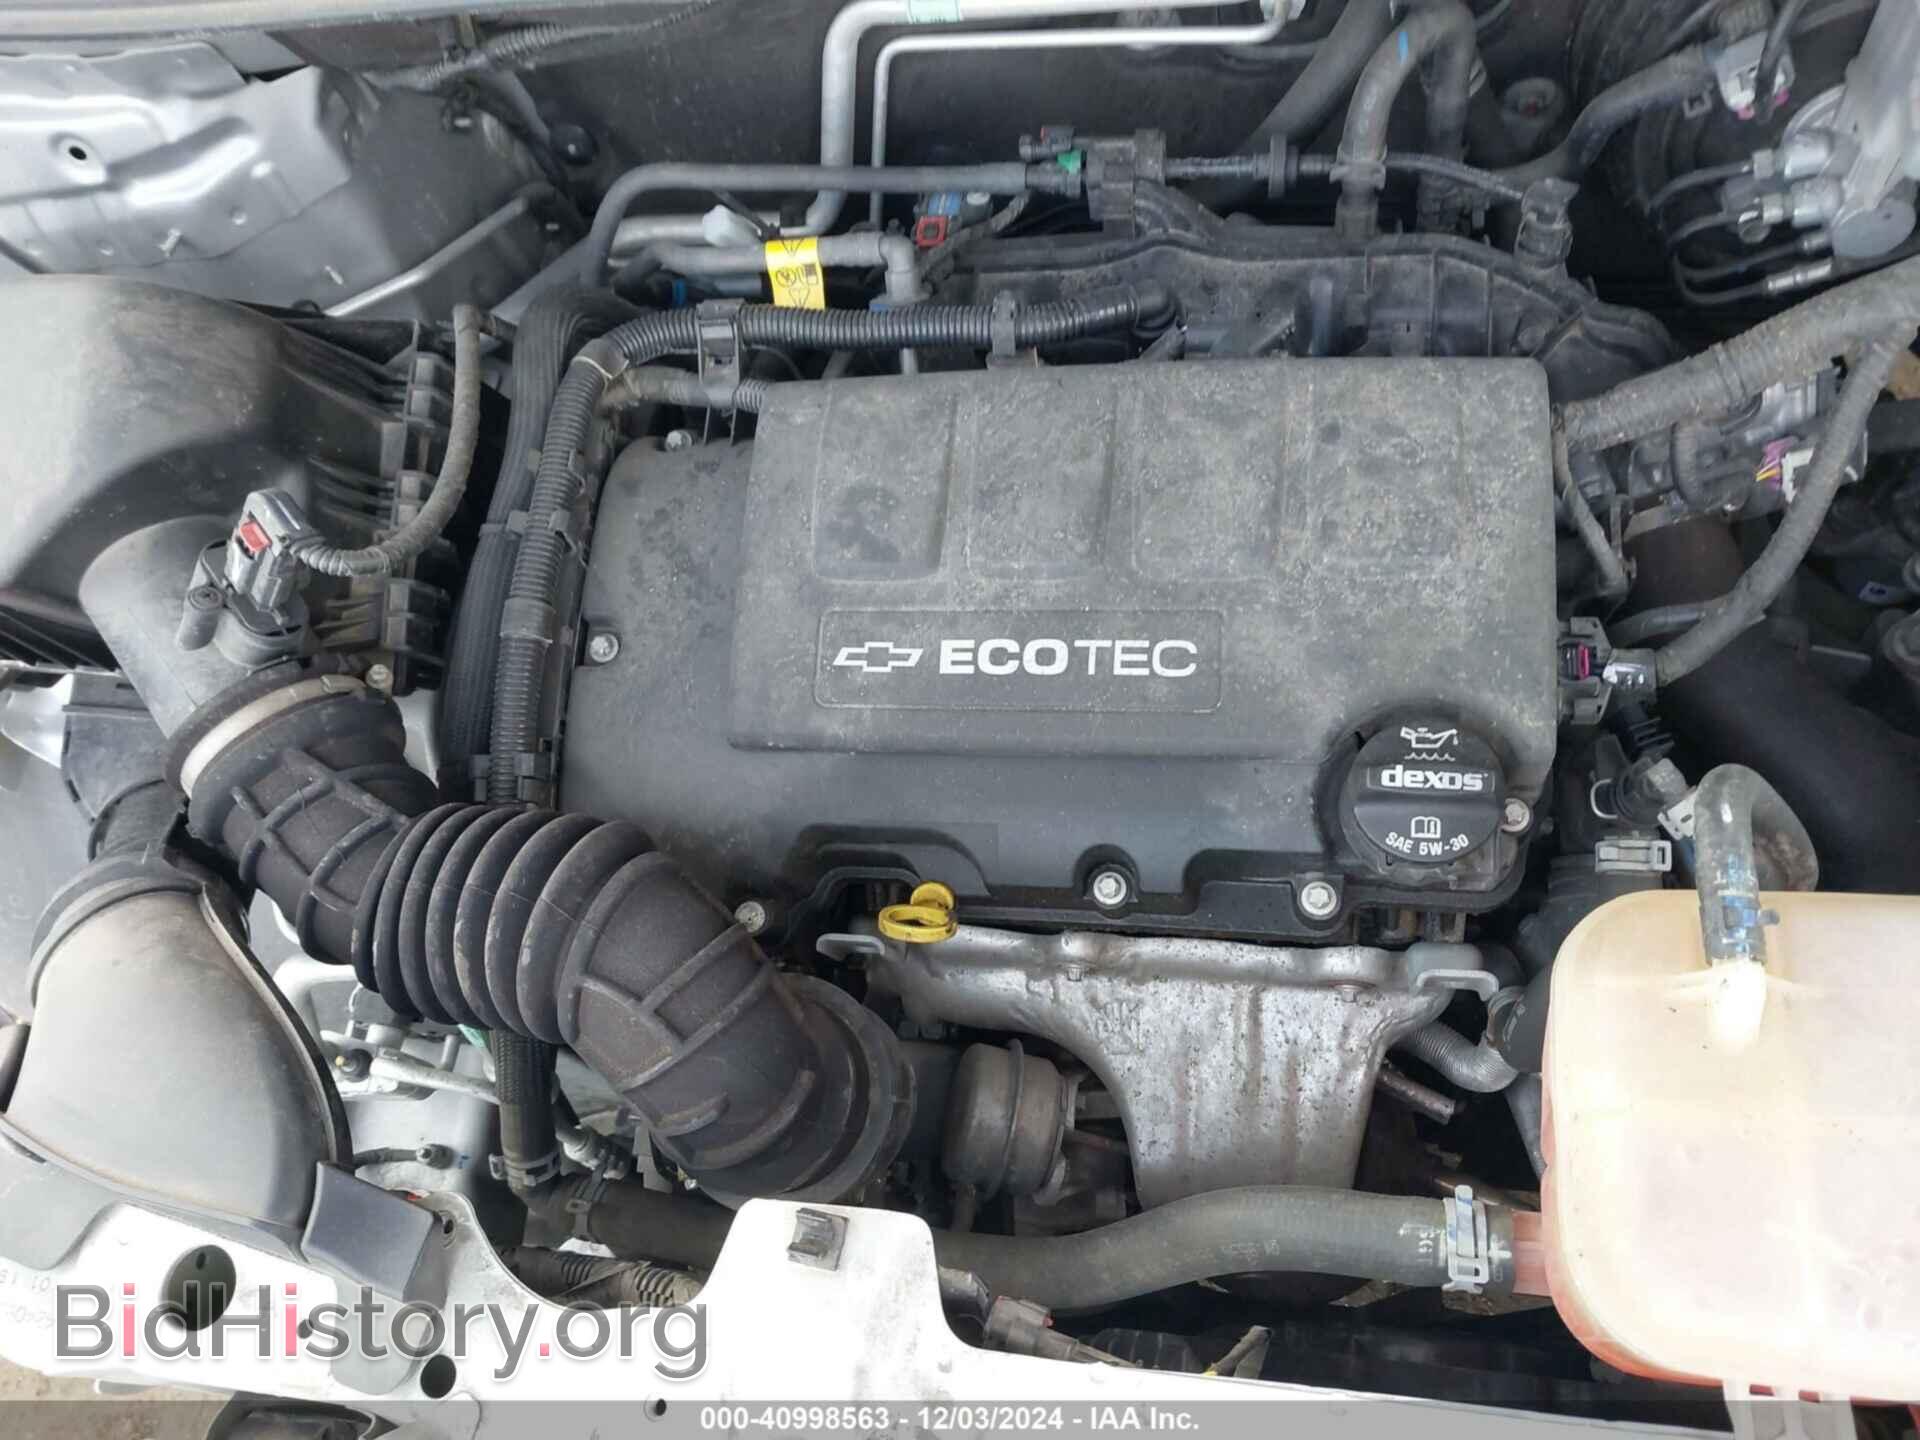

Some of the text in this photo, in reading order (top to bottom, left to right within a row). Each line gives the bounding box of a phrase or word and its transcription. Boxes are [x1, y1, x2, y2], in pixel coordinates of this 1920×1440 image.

[939, 638, 1198, 677] ECOTEC
[1380, 764, 1484, 792] dexos
[1385, 831, 1470, 857] SAE 5W-30
